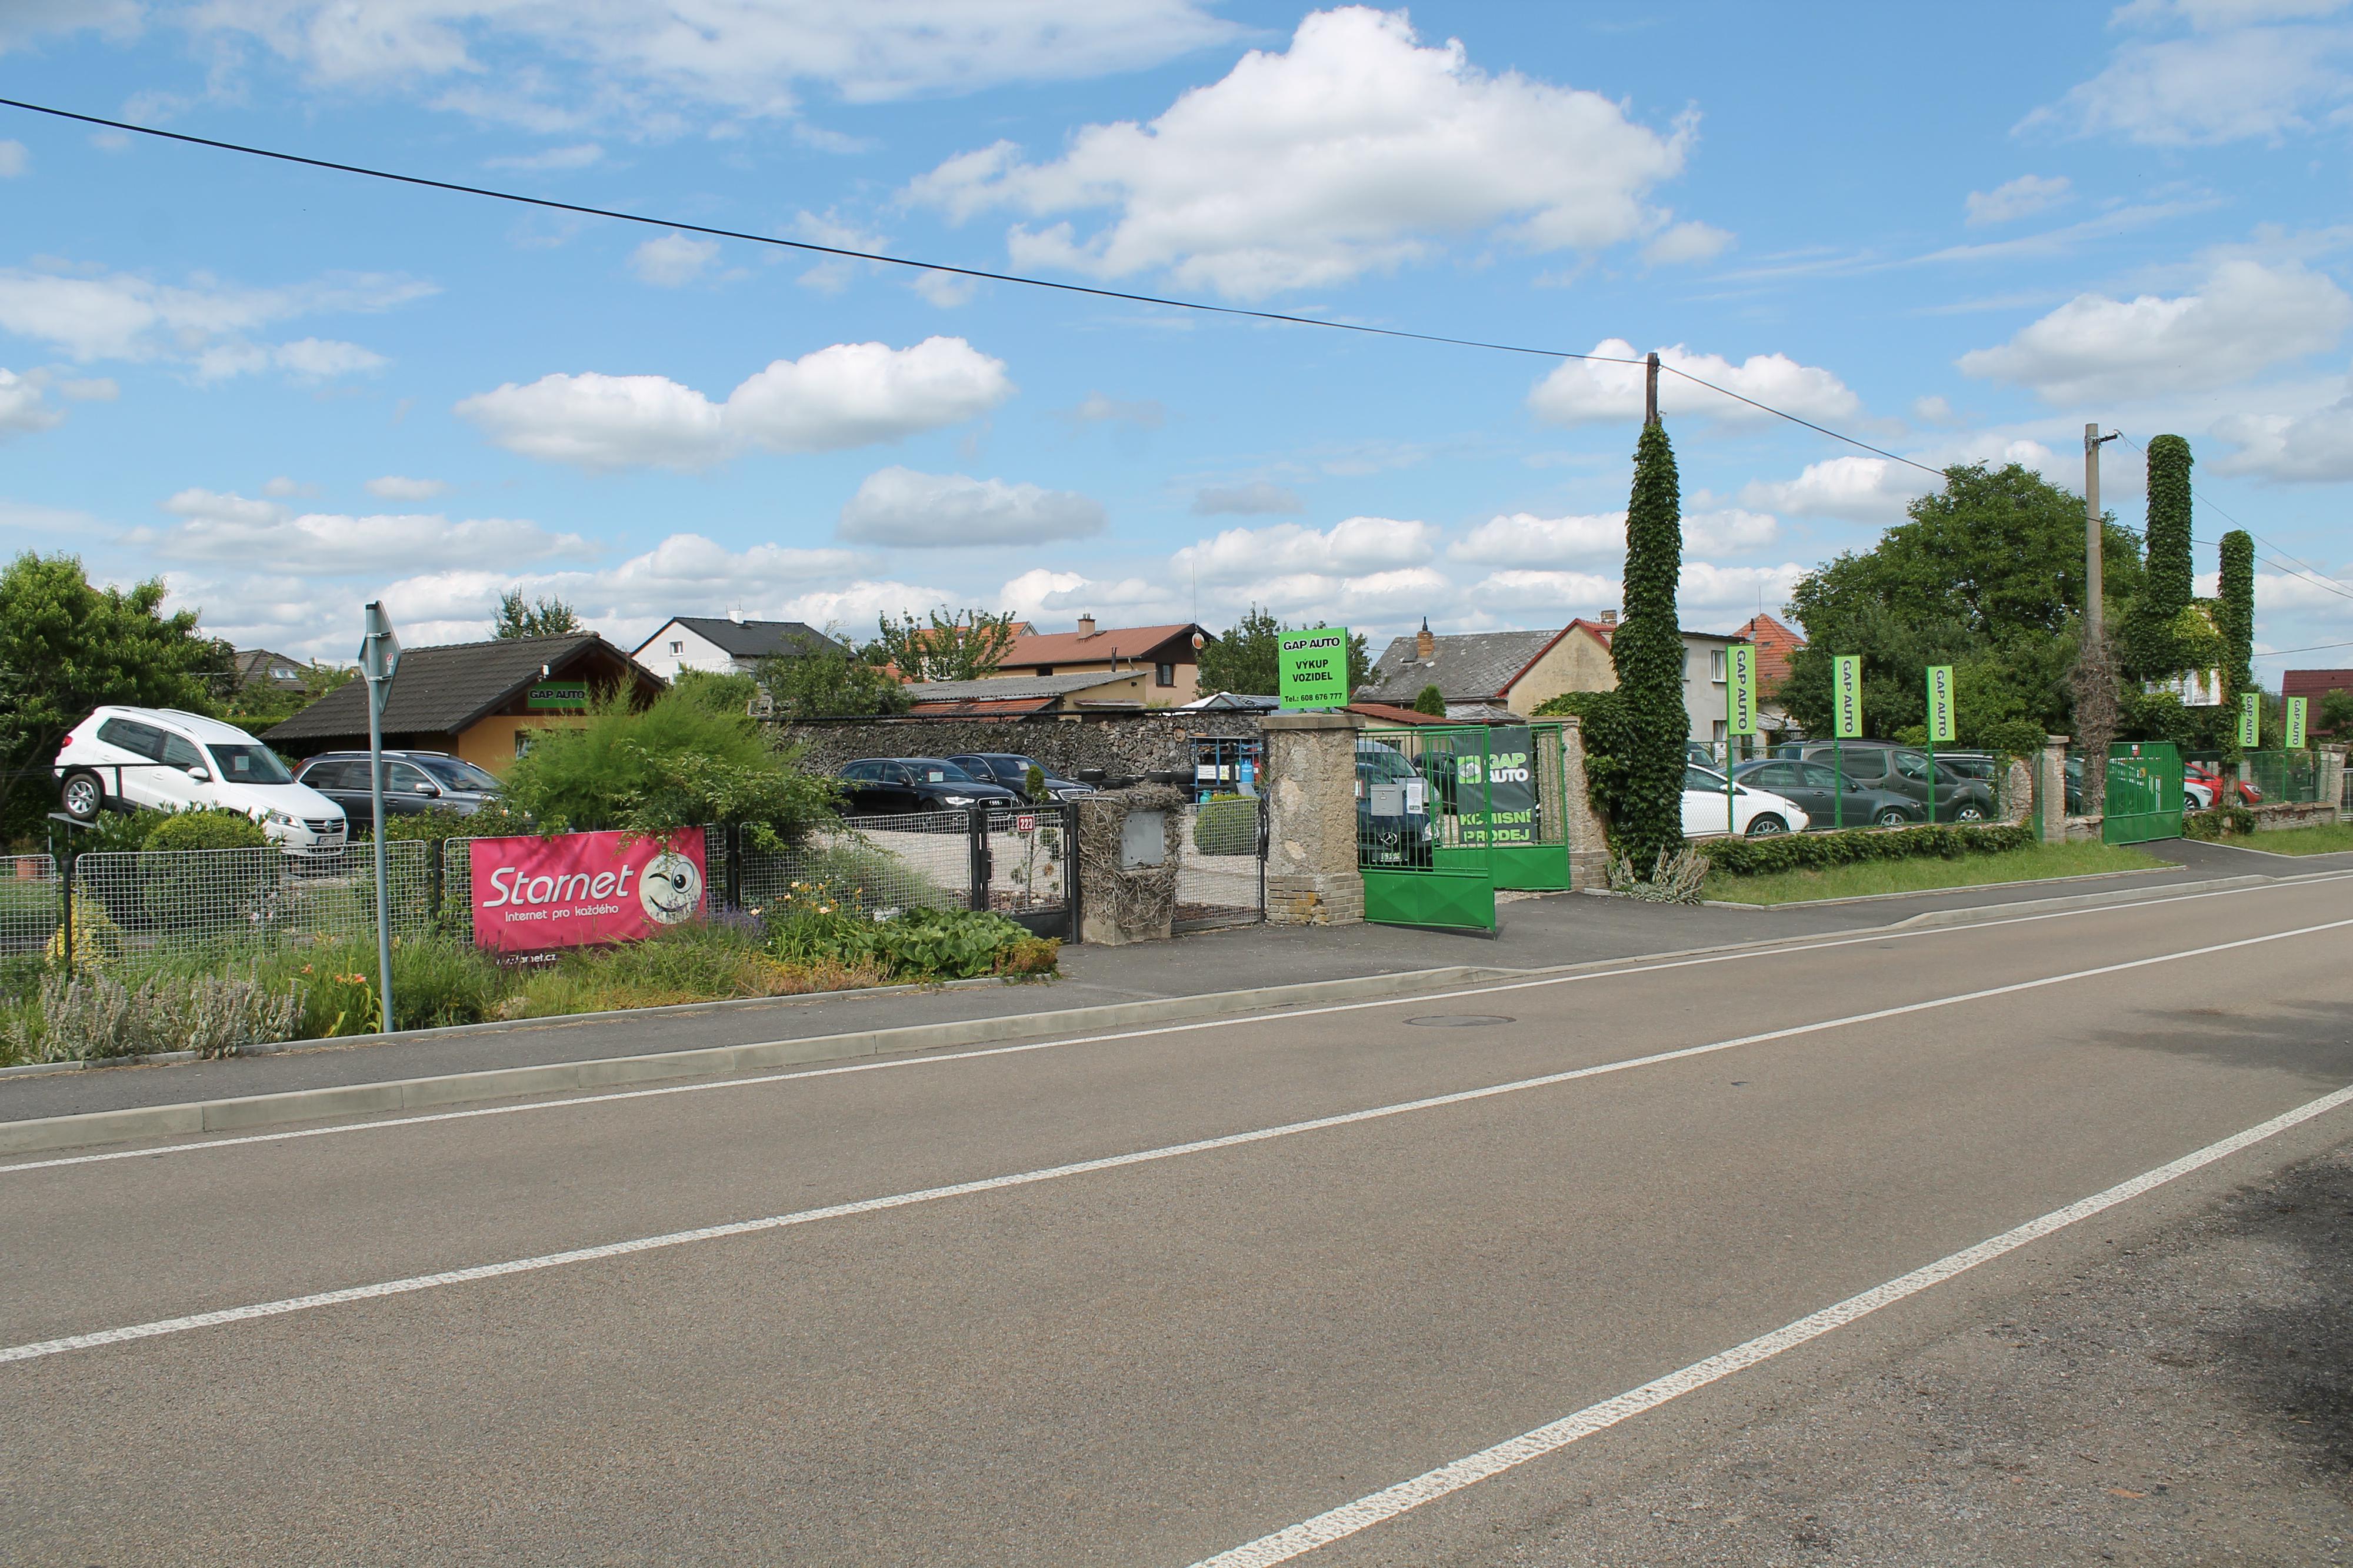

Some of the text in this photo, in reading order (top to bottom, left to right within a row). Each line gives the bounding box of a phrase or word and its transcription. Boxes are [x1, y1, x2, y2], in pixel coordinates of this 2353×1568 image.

[1284, 637, 1341, 650] GAP AUTO
[1296, 659, 1328, 669] VÝKUP
[1292, 672, 1333, 682] VOZIDEL
[529, 690, 585, 699] GAP AUTO
[1737, 649, 1747, 730] GAP AUTO
[1843, 660, 1853, 733] GAP AUTO
[1937, 670, 1947, 737] GAP AUTO
[1020, 818, 1033, 829] 223
[482, 865, 634, 907] Starnet
[505, 903, 619, 922] Internet pro každého
